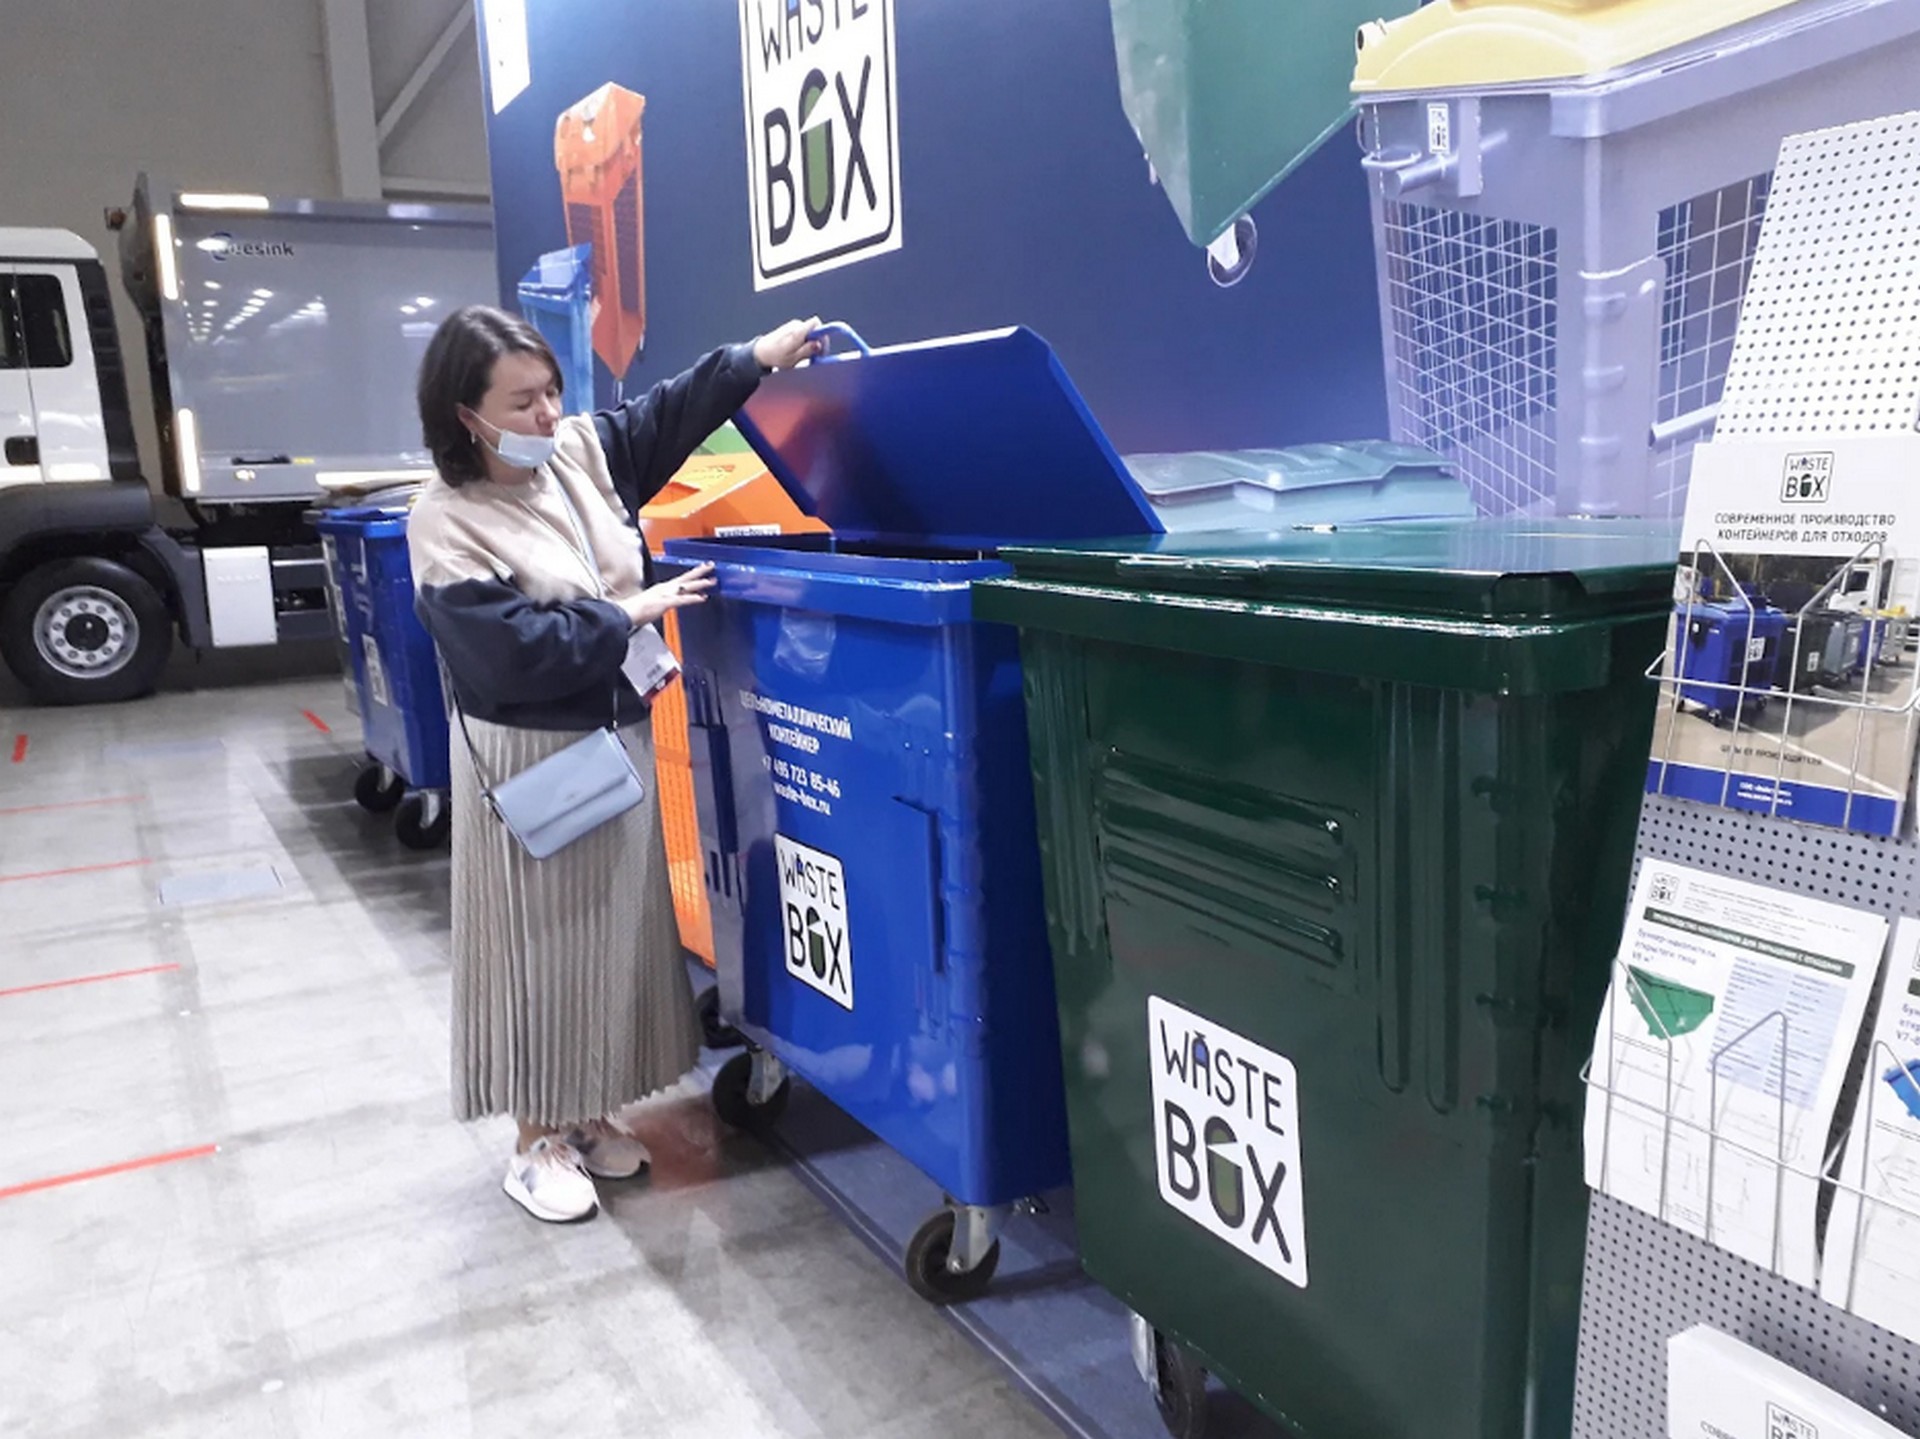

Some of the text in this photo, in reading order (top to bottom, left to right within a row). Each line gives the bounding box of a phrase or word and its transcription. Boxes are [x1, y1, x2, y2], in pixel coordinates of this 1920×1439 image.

[758, 0, 869, 73] WAS
[764, 54, 877, 247] BOX
[1785, 474, 1826, 498] BOX
[1790, 457, 1829, 471] WASTE
[1714, 512, 1896, 527] СОВРЕМЕННОЕ ПРОИЗВОДСТВО
[1717, 528, 1888, 543] КОНТЕЙНЕРОВ ДЛЯ ОТХОДОВ
[767, 722, 821, 755] КОНТЕЙНЕР
[790, 764, 808, 787] 723
[780, 849, 841, 911] WASTE
[786, 900, 848, 995] BOX
[1160, 1018, 1285, 1136] WASTE
[1164, 1098, 1292, 1265] BOX
